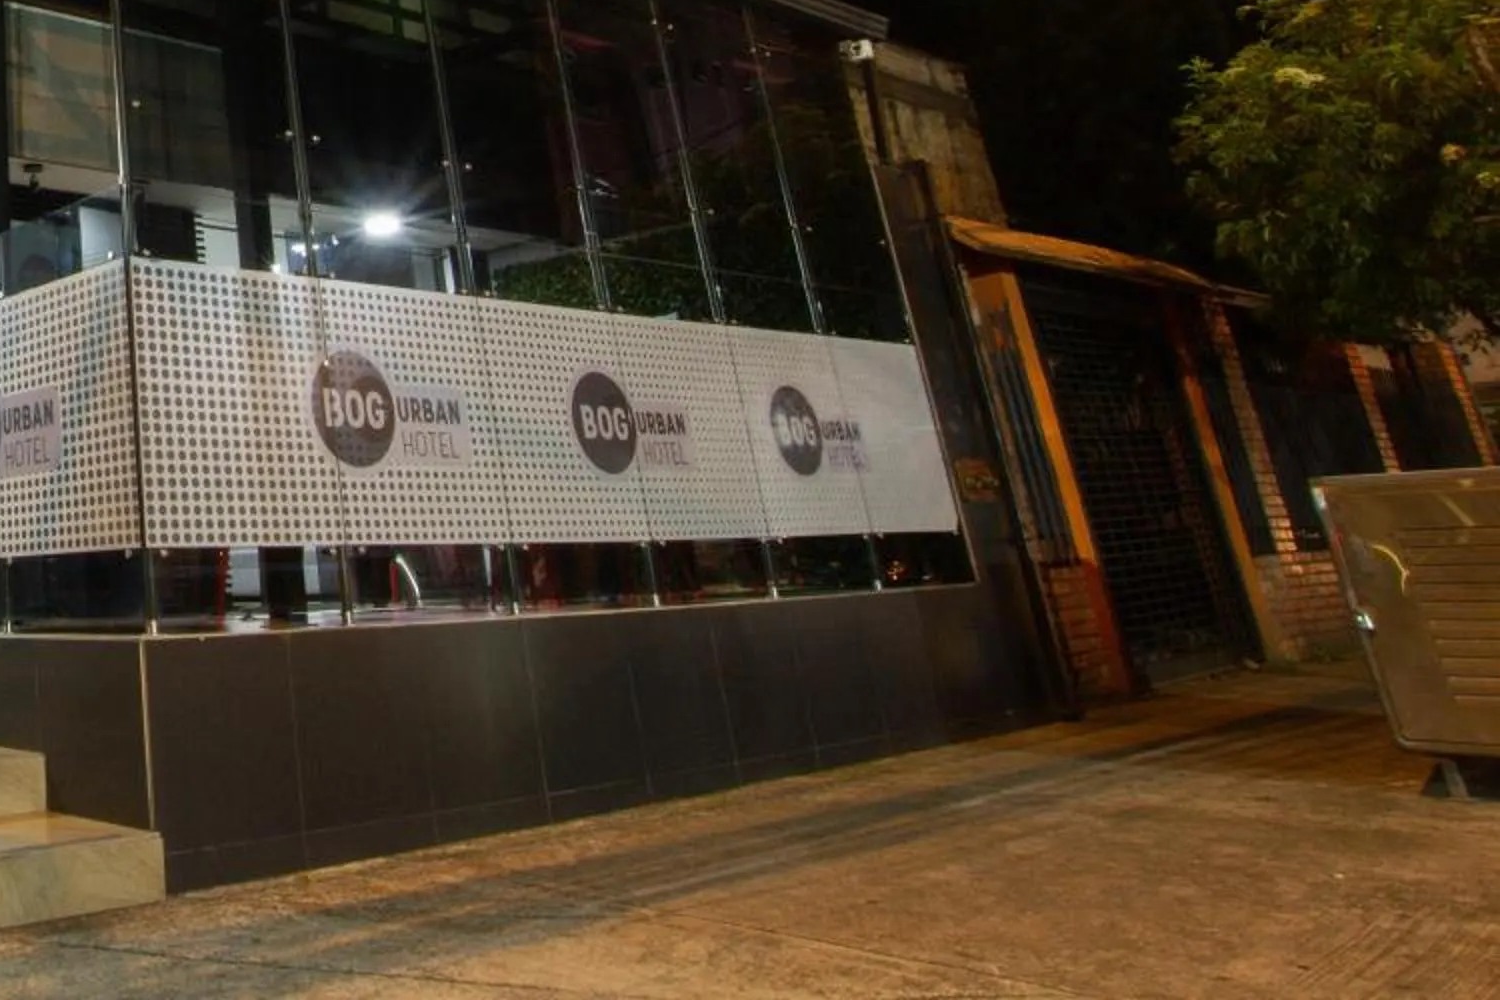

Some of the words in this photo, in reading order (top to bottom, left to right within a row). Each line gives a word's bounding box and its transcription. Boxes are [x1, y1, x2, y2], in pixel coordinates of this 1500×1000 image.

[3, 399, 54, 434] URBAN
[322, 387, 385, 430] BOG
[395, 396, 461, 425] URBAN
[580, 403, 629, 440] BOG
[636, 410, 686, 436] URBAN
[776, 411, 817, 447] BOG
[821, 420, 861, 441] URBAN
[5, 436, 50, 468] HOTEL
[402, 431, 461, 459] HOTEL
[642, 441, 690, 467] HOTEL
